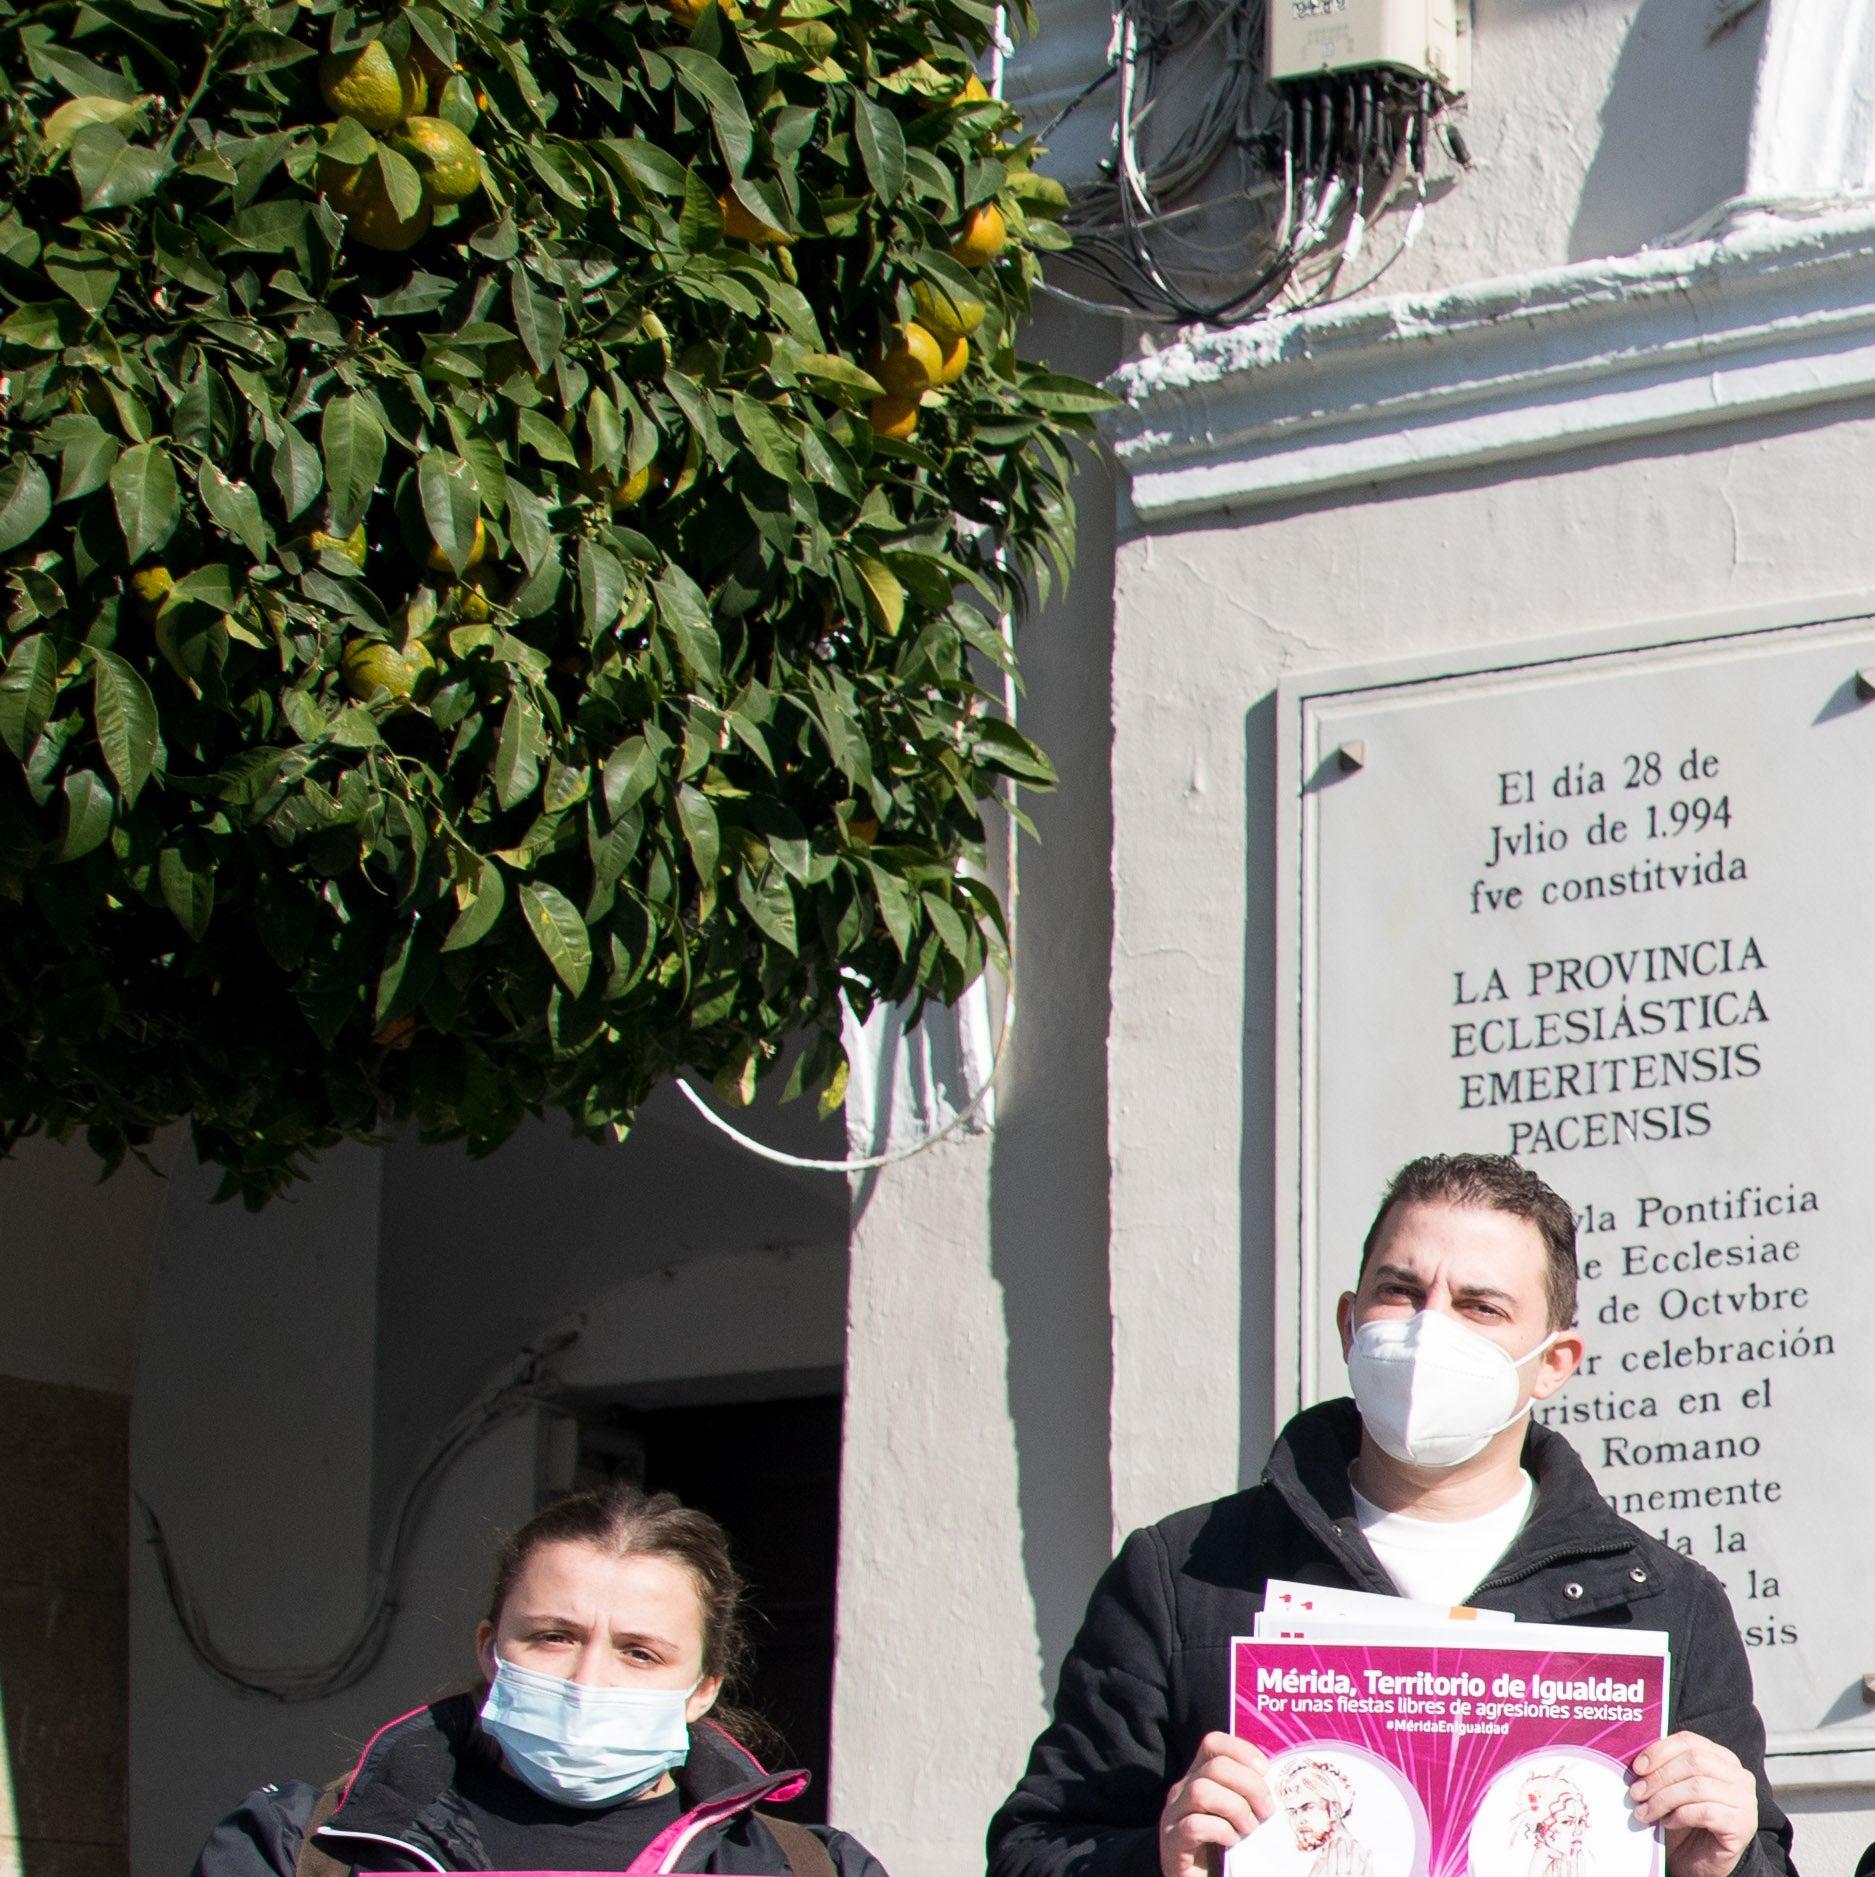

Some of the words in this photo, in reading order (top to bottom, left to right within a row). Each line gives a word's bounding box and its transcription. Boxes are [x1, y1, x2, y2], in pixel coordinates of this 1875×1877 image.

[1499, 770, 1534, 805] El
[1553, 763, 1605, 797] día
[1625, 752, 1661, 789] 28
[1680, 747, 1718, 781] de
[1485, 821, 1568, 868] Jvlio
[1587, 812, 1627, 845] de
[1648, 796, 1731, 838] 1.994
[1471, 880, 1522, 913] fve
[1543, 850, 1747, 904] constitvida
[1454, 969, 1509, 1005] LA
[1529, 937, 1766, 996] PROVINCIA
[1461, 1044, 1760, 1109] EMERITENSIS
[1509, 1102, 1711, 1156] PACENSIS
[1638, 1184, 1818, 1227] Pontificia
[1622, 1235, 1799, 1276] Ecclesiae
[1599, 1296, 1638, 1324] de
[1660, 1283, 1807, 1320] Octvbre
[1622, 1327, 1834, 1372] celebración
[1679, 1393, 1720, 1414] en
[1742, 1378, 1771, 1408] el
[1603, 1437, 1760, 1467] Romano
[1715, 1524, 1746, 1553] la
[1749, 1570, 1779, 1599] la
[1745, 1616, 1797, 1646] sis
[1258, 1668, 1357, 1698] Mérida,
[1364, 1671, 1485, 1697] Territorio
[1492, 1675, 1527, 1699] de
[1532, 1675, 1644, 1705] Igualdad
[1257, 1696, 1287, 1713] Por
[1292, 1700, 1333, 1714] unas
[1337, 1698, 1394, 1713] fiestas
[1398, 1699, 1445, 1714] libres
[1450, 1701, 1471, 1718] de
[1476, 1703, 1570, 1720] agresiones
[1574, 1705, 1643, 1721] sexistas
